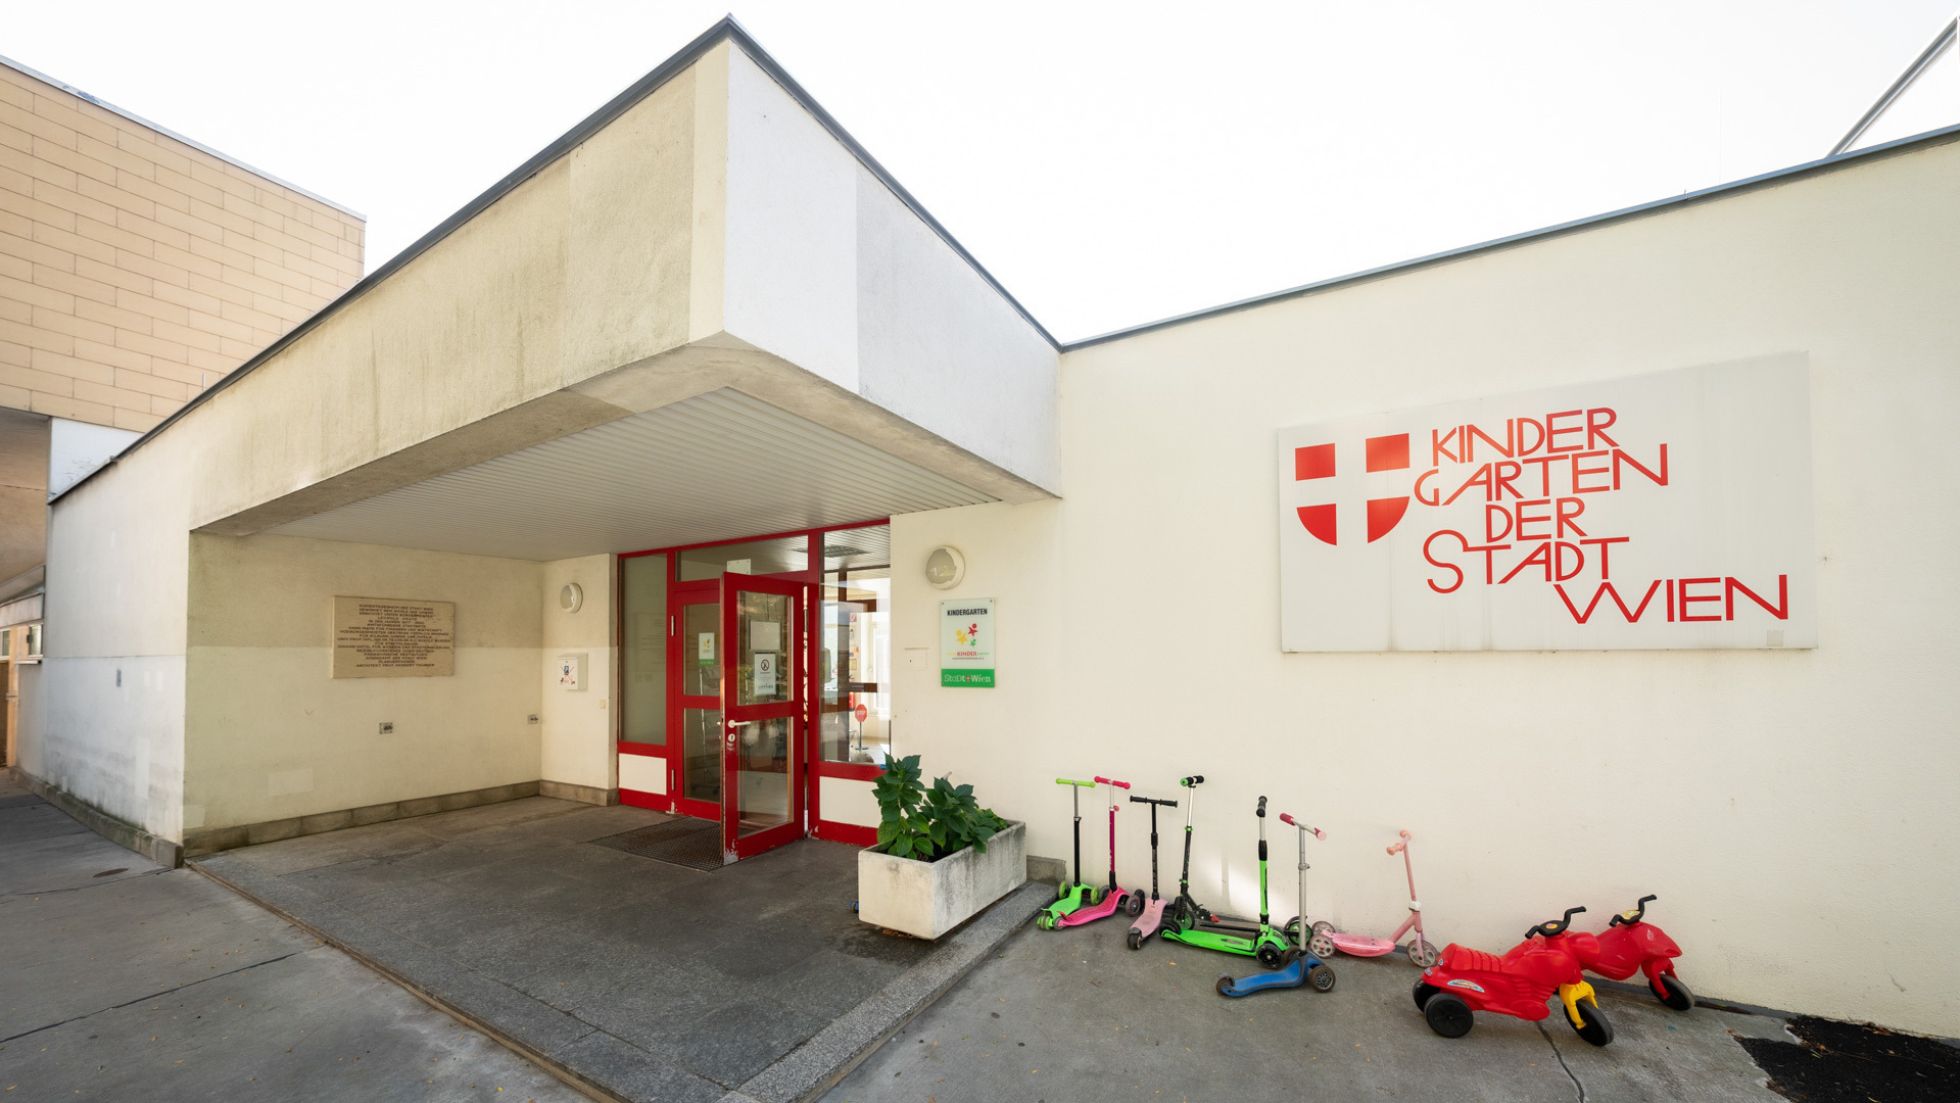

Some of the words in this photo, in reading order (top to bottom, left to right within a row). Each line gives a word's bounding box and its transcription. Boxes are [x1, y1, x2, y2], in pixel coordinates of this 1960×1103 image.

[1432, 407, 1620, 466] KINDER
[1414, 443, 1669, 507] GARTEN
[1486, 496, 1588, 543] DER
[1422, 529, 1631, 595] STADT
[946, 608, 988, 616] KINDERGARTEN
[1553, 574, 1790, 625] WIEN
